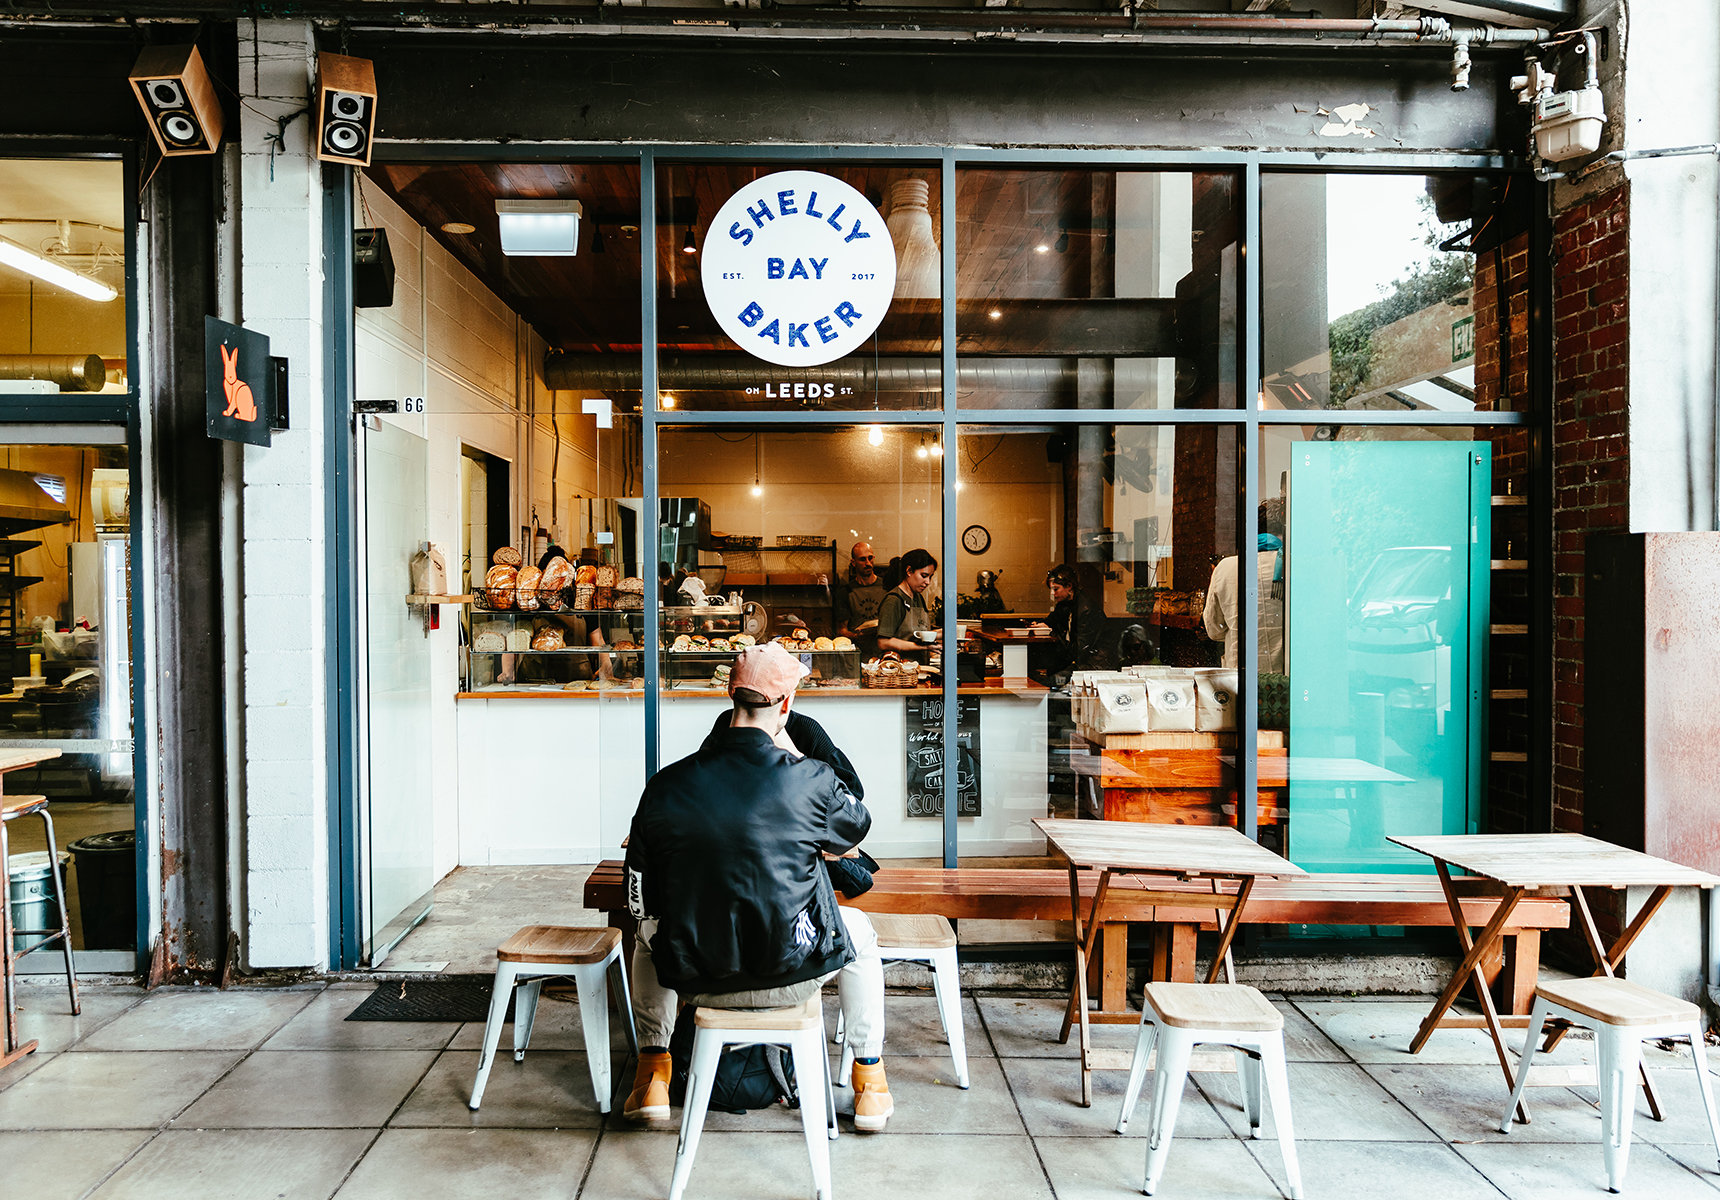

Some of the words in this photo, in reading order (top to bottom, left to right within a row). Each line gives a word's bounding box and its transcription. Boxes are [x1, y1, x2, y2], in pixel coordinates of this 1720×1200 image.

[729, 189, 871, 247] SHELLY
[722, 272, 744, 280] EST.
[767, 257, 829, 280] BAY
[737, 301, 863, 348] BAKER
[745, 387, 760, 395] ON
[765, 383, 835, 398] LEEDS
[840, 387, 854, 395] ST.
[405, 397, 423, 413] 6G
[922, 700, 964, 720] HOE
[909, 731, 938, 742] World
[907, 791, 978, 814] COOIE
